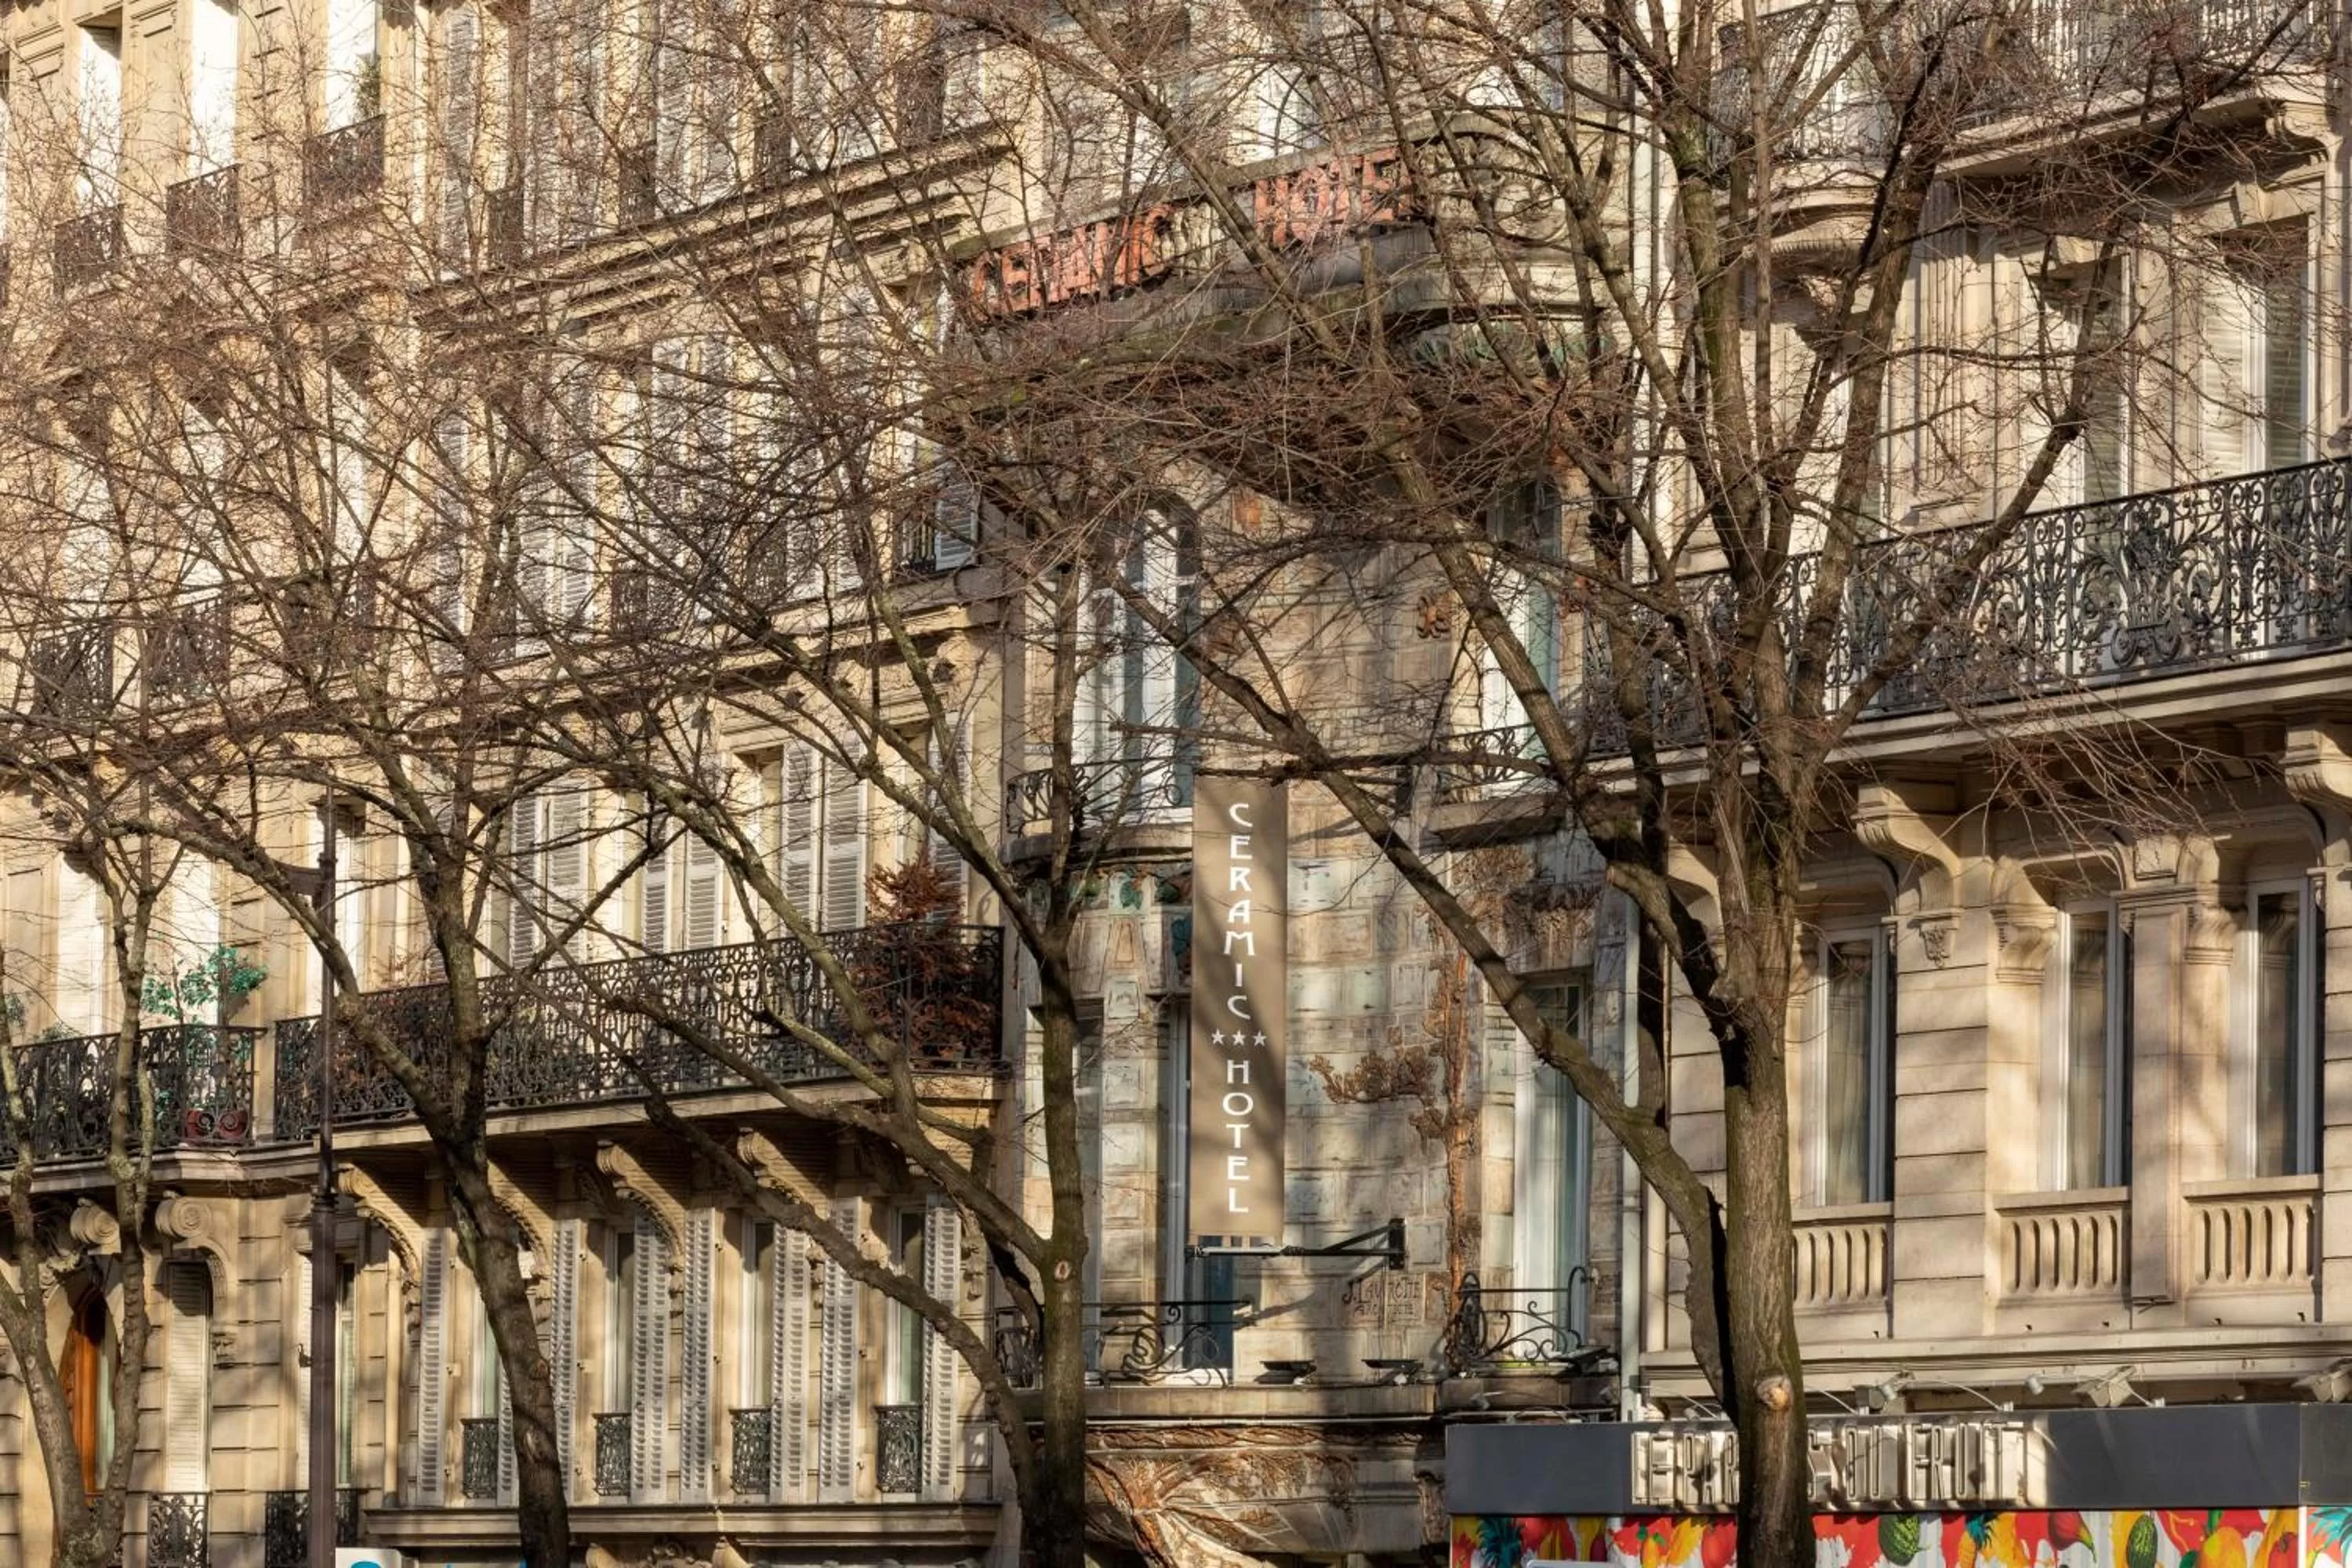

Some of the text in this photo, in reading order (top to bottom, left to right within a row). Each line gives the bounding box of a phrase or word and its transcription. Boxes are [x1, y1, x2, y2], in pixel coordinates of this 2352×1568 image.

[1223, 803, 1255, 1213] CERAMIC HOTEL
[1632, 1420, 2018, 1504] LE PARS DU FRUIT
